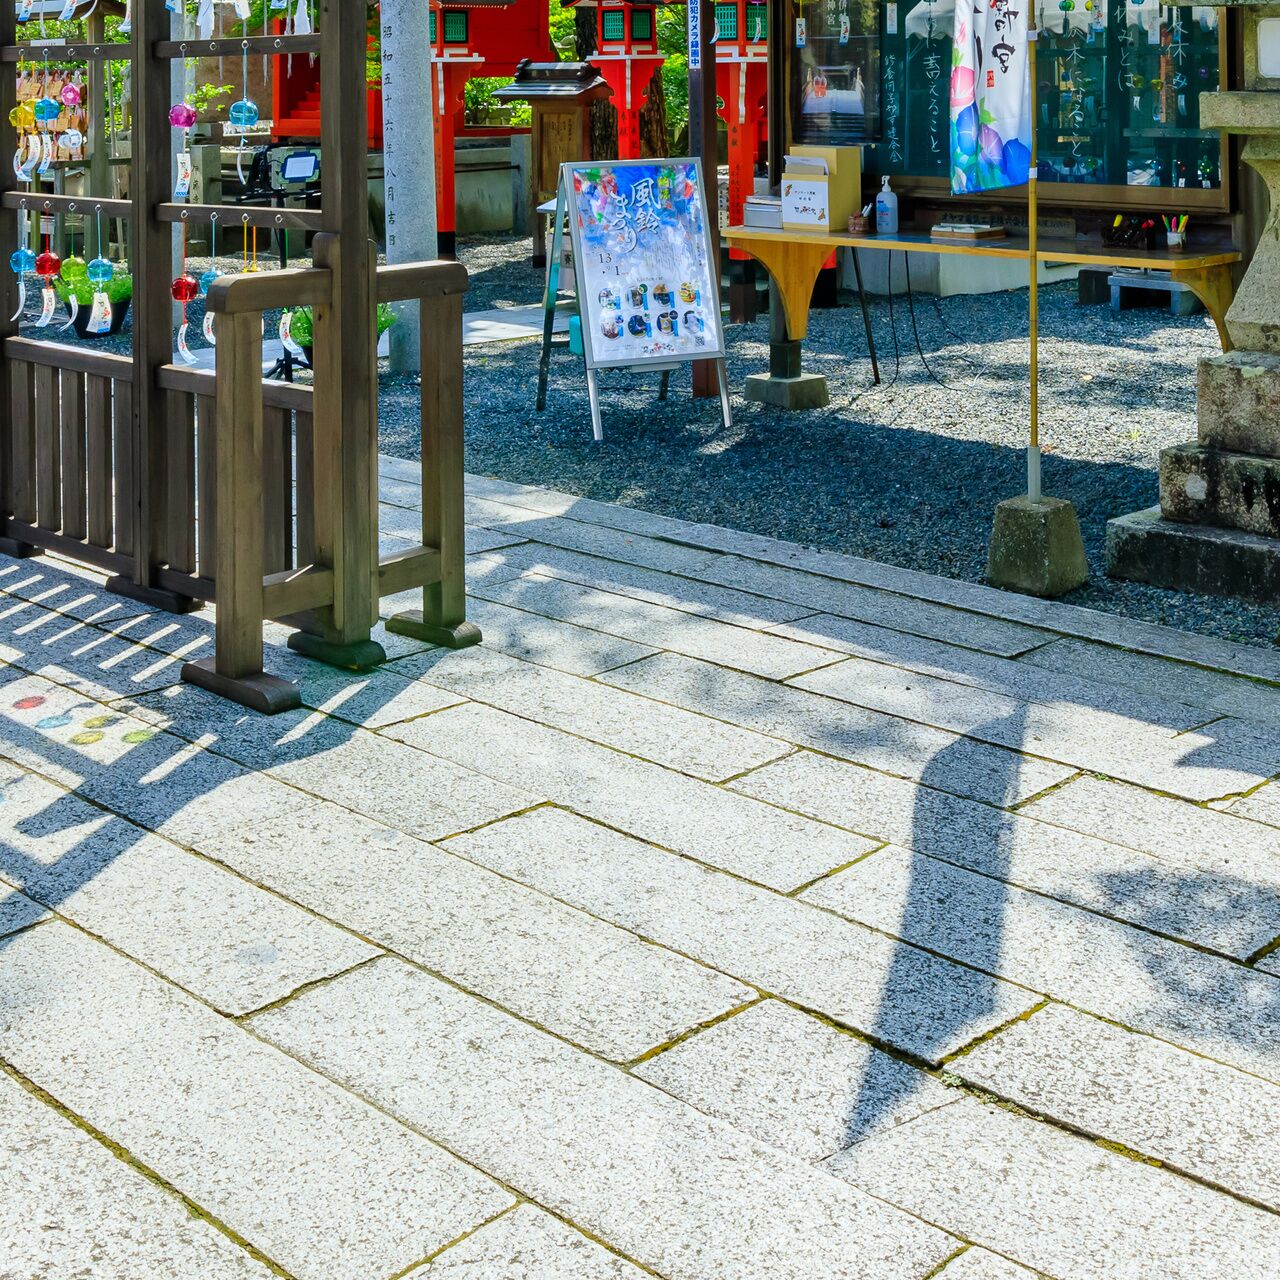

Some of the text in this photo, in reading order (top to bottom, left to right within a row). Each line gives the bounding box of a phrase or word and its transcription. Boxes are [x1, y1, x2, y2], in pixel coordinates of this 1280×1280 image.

[825, 0, 836, 25] 神宮
[1114, 5, 1136, 92] 休みとは
[382, 25, 398, 247] 昭和五十六年八月吉日
[610, 191, 637, 254] まつり
[630, 176, 662, 235] 風鈴
